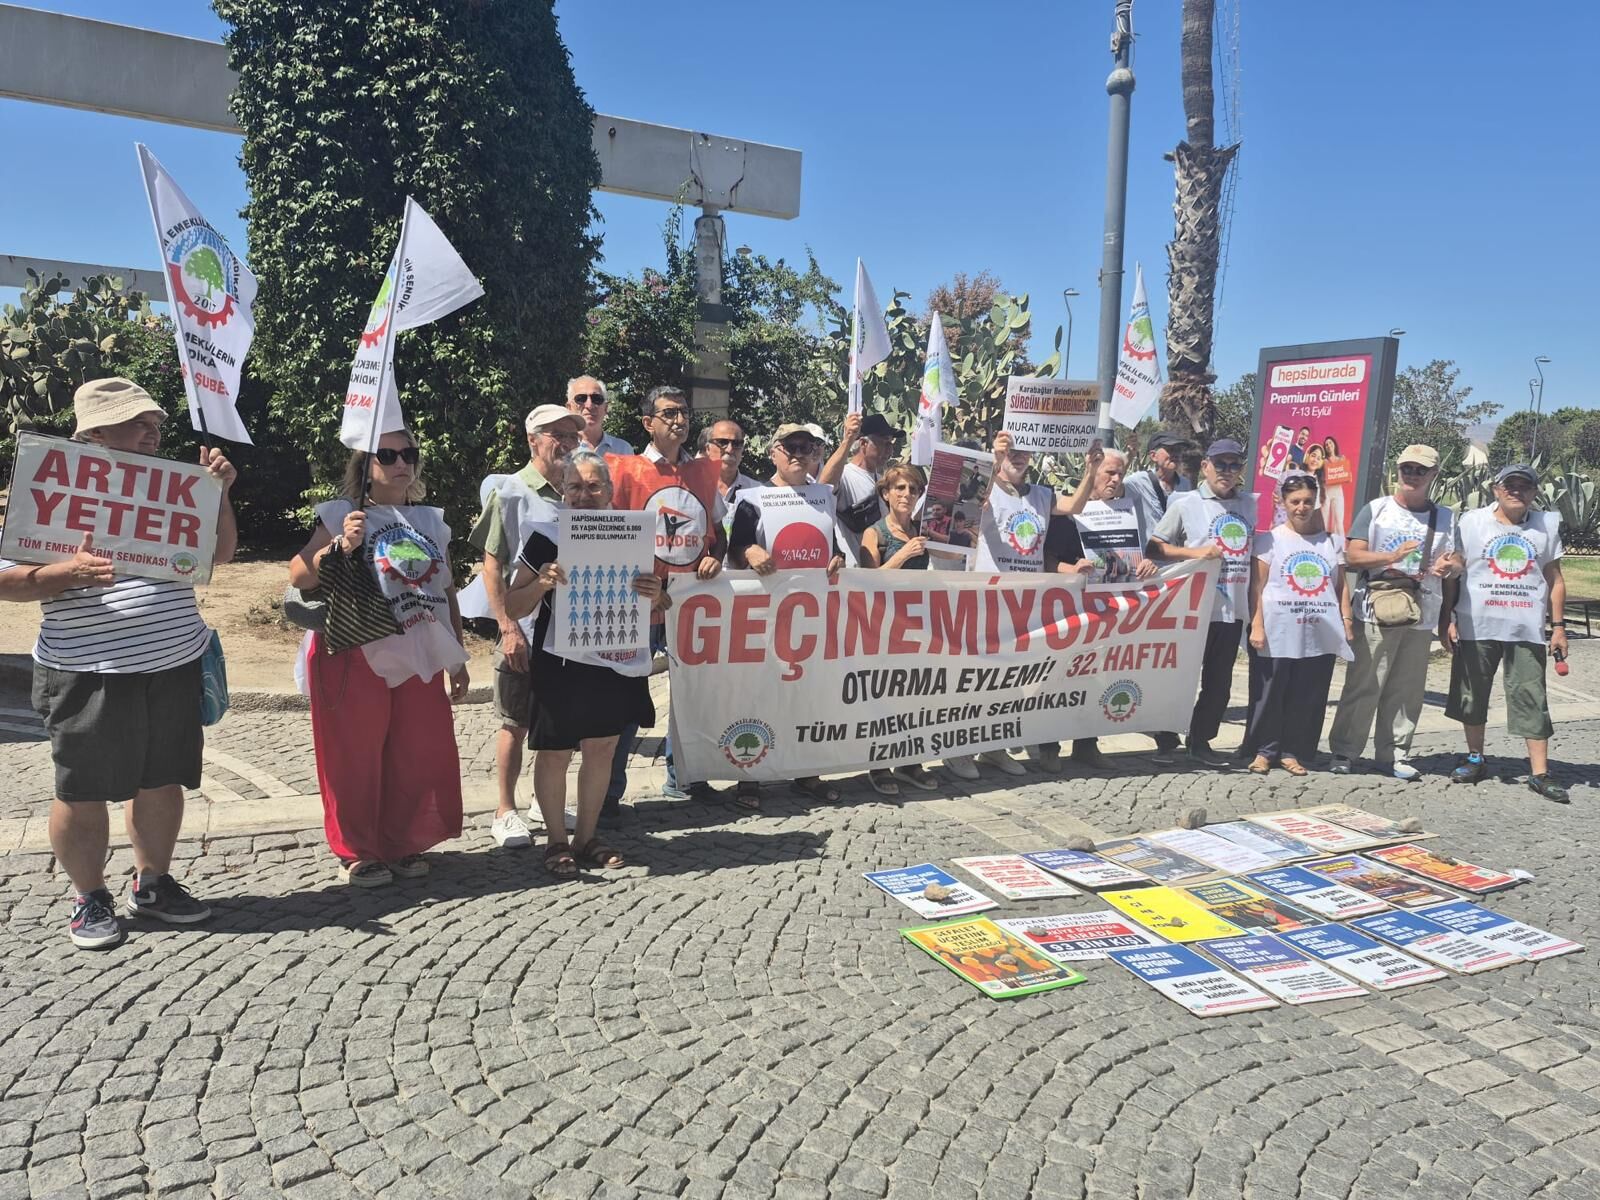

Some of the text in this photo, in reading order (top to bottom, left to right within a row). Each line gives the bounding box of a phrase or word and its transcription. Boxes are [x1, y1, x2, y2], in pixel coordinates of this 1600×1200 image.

[194, 296, 216, 312] 2017
[1278, 363, 1357, 384] hepsiburada
[1019, 385, 1052, 396] Karabağlar
[1270, 389, 1360, 404] Premium Günleri
[1010, 394, 1041, 410] SÜRGÜN
[1042, 397, 1051, 411] VE
[1291, 406, 1331, 418] 7-13 Eylül
[1007, 421, 1040, 433] MURAT
[1014, 435, 1088, 448] YALNIZ DEĞİLDİR!
[1270, 442, 1287, 468] 9
[32, 449, 200, 508] ARTIK
[30, 488, 201, 548] YETER
[571, 514, 626, 522] HAPİSHANELERDE
[580, 524, 597, 532] YAŞIN
[598, 523, 625, 531] ÜZERİNDE
[18, 537, 42, 549] TÜM
[116, 551, 168, 567] SENDİKASI
[782, 548, 821, 561] %142,47
[1511, 600, 1534, 608] ŞUBESİ
[676, 571, 1208, 682] GEÇİNEMİYORUZ!
[1066, 642, 1178, 678] 32. HAFTA
[842, 656, 1057, 704] OTURMA EYLEMİ!
[796, 690, 1087, 742] TÜM EMEKLİLERİN SENDİKASI
[869, 717, 1022, 762] İZMİR ŞUBELERİ
[1008, 917, 1048, 927] DOLAR
[1061, 918, 1106, 927] HIZINDA
[1076, 922, 1120, 933] DÜNYADA
[934, 925, 977, 937] SEFALET
[938, 930, 987, 943] ÜCRETİNE
[952, 941, 1002, 953] OLMAYACAĞIZ
[953, 937, 991, 948] TESLİM
[1051, 935, 1143, 952] 93 BİN KİŞİ
[1056, 950, 1093, 958] DOLAR
[1121, 951, 1173, 963] SAĞLIKTA
[1132, 957, 1184, 969] SOYGUNA
[1141, 967, 1172, 976] SON!
[1172, 976, 1227, 989] Katkı payları
[1190, 986, 1204, 996] ilaç
[1204, 982, 1237, 993] farkları
